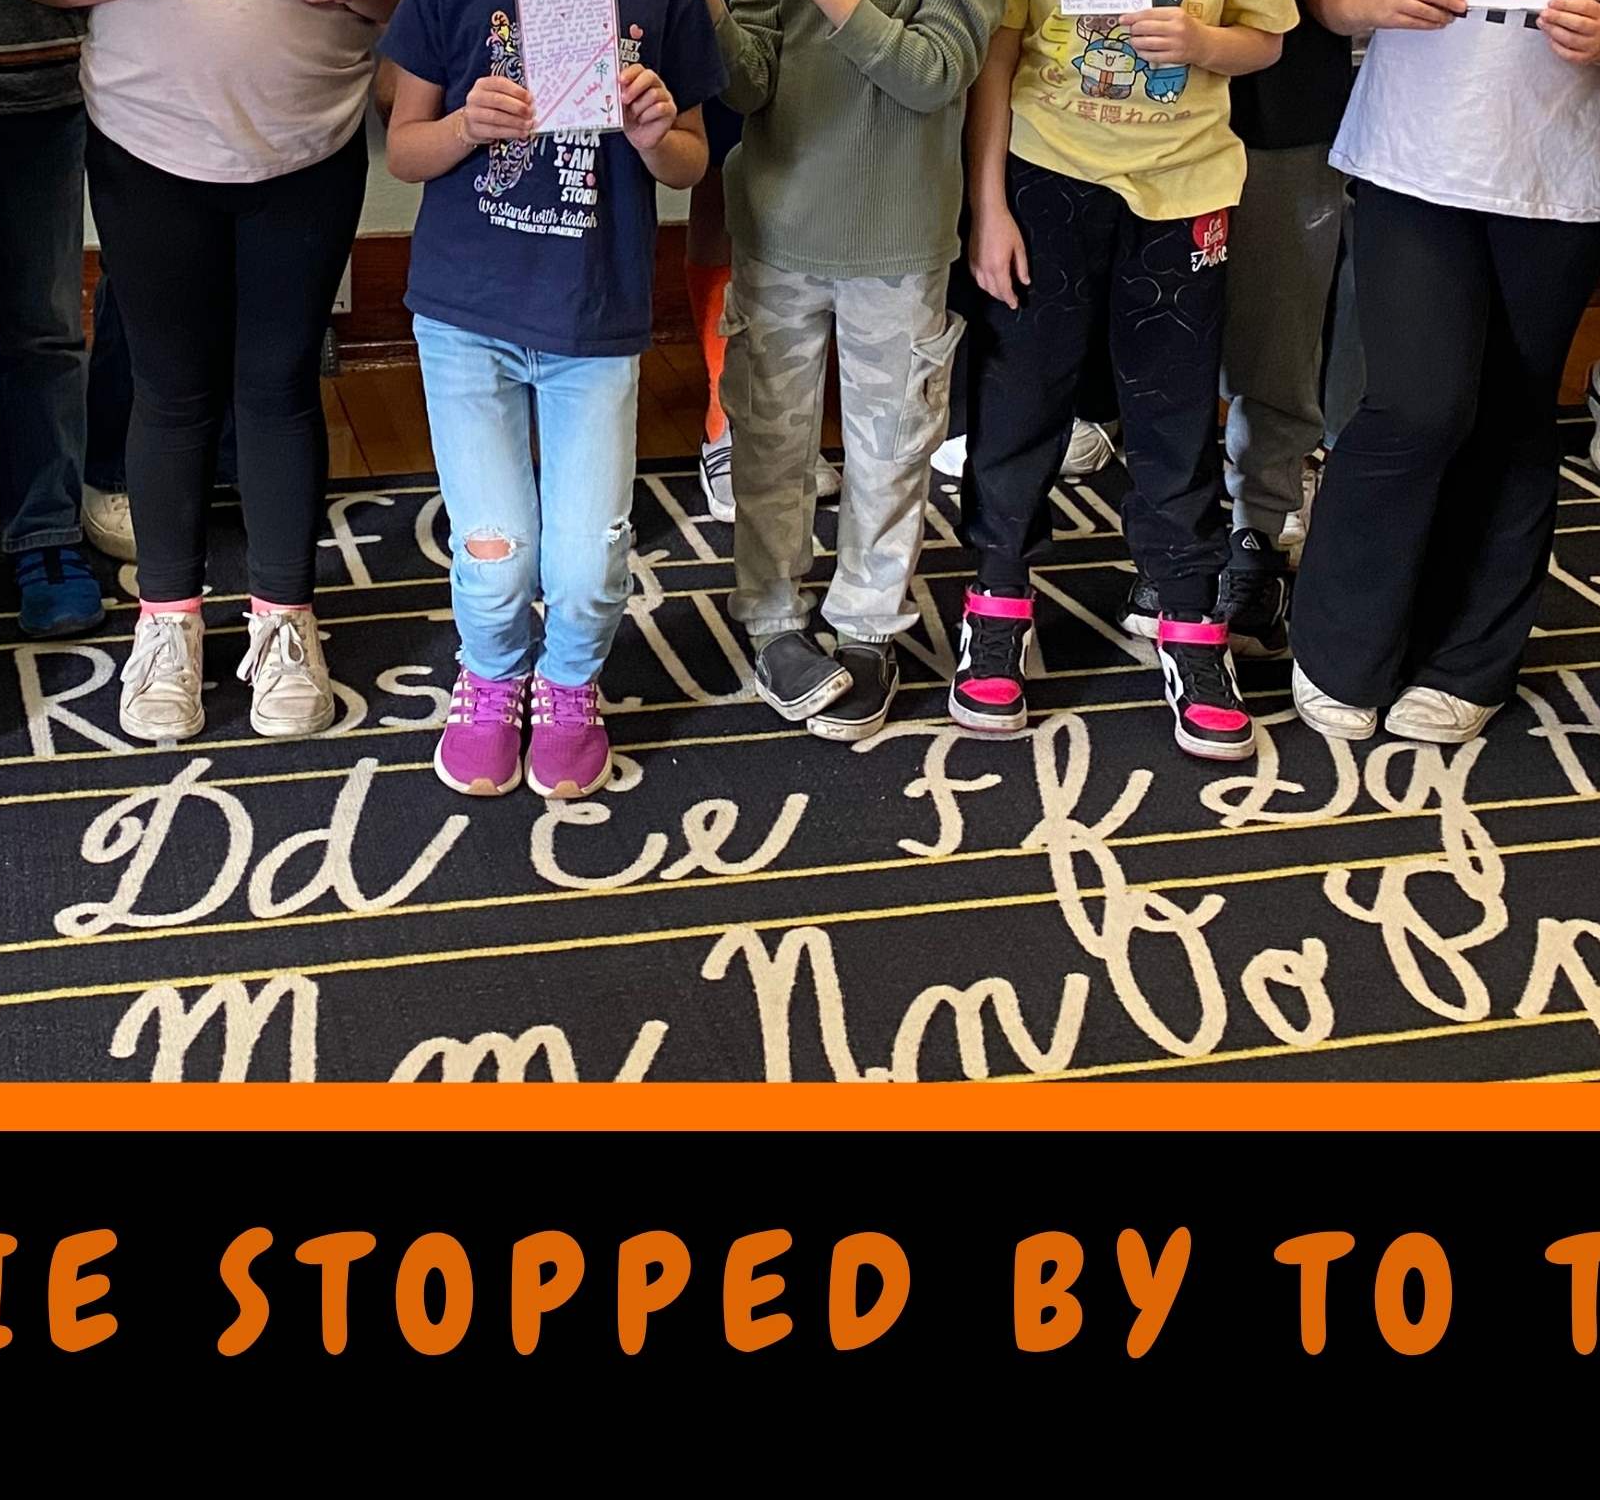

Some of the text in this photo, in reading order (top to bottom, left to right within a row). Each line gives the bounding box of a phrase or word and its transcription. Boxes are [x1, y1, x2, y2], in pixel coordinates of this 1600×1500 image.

[569, 149, 595, 171] AM
[558, 169, 586, 186] THE
[479, 197, 497, 215] We
[498, 202, 531, 221] stand
[532, 209, 558, 226] with
[52, 757, 469, 939] Dd
